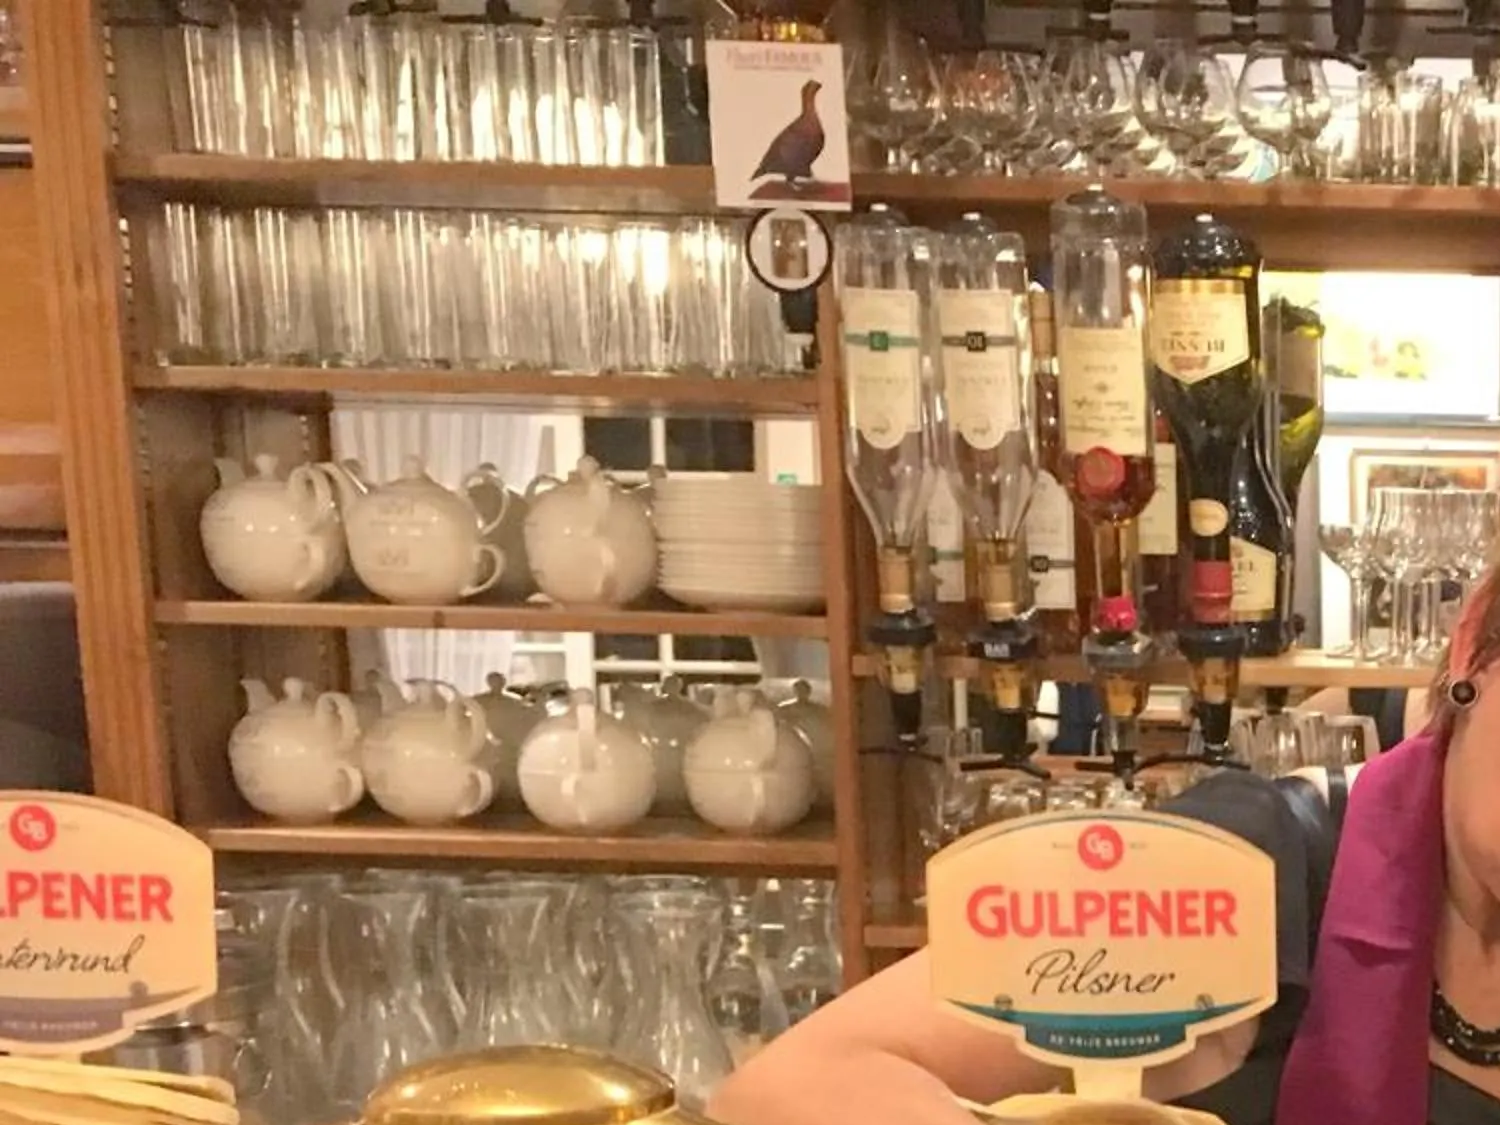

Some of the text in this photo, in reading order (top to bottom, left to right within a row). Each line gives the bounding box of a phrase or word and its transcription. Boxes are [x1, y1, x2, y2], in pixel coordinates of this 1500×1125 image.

[0, 871, 174, 923] PENER
[966, 885, 1239, 938] GULPENER
[1025, 948, 1176, 996] Pilsner
